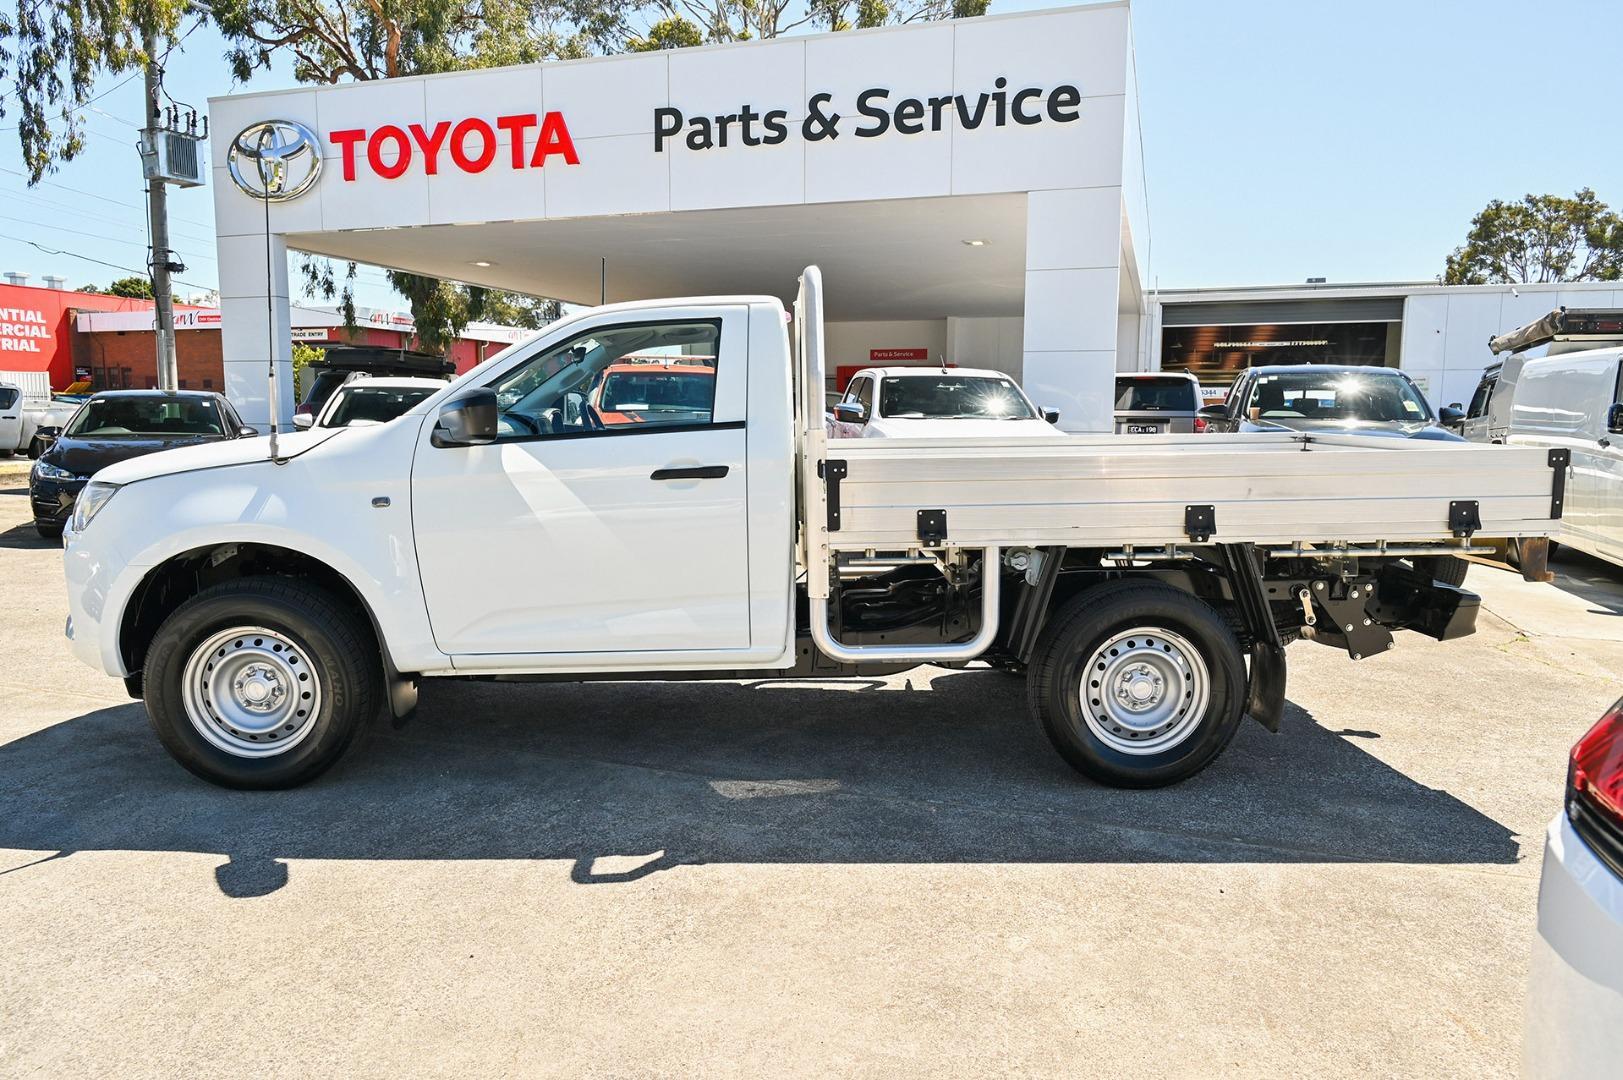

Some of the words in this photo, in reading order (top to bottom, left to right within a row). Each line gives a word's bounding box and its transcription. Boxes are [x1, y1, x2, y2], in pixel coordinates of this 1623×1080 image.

[654, 105, 788, 152] Parts
[801, 92, 841, 141] &
[854, 76, 1081, 138] Service
[329, 111, 580, 182] TOYOTA
[0, 322, 52, 338] RCIAL
[0, 337, 41, 352] RIAL
